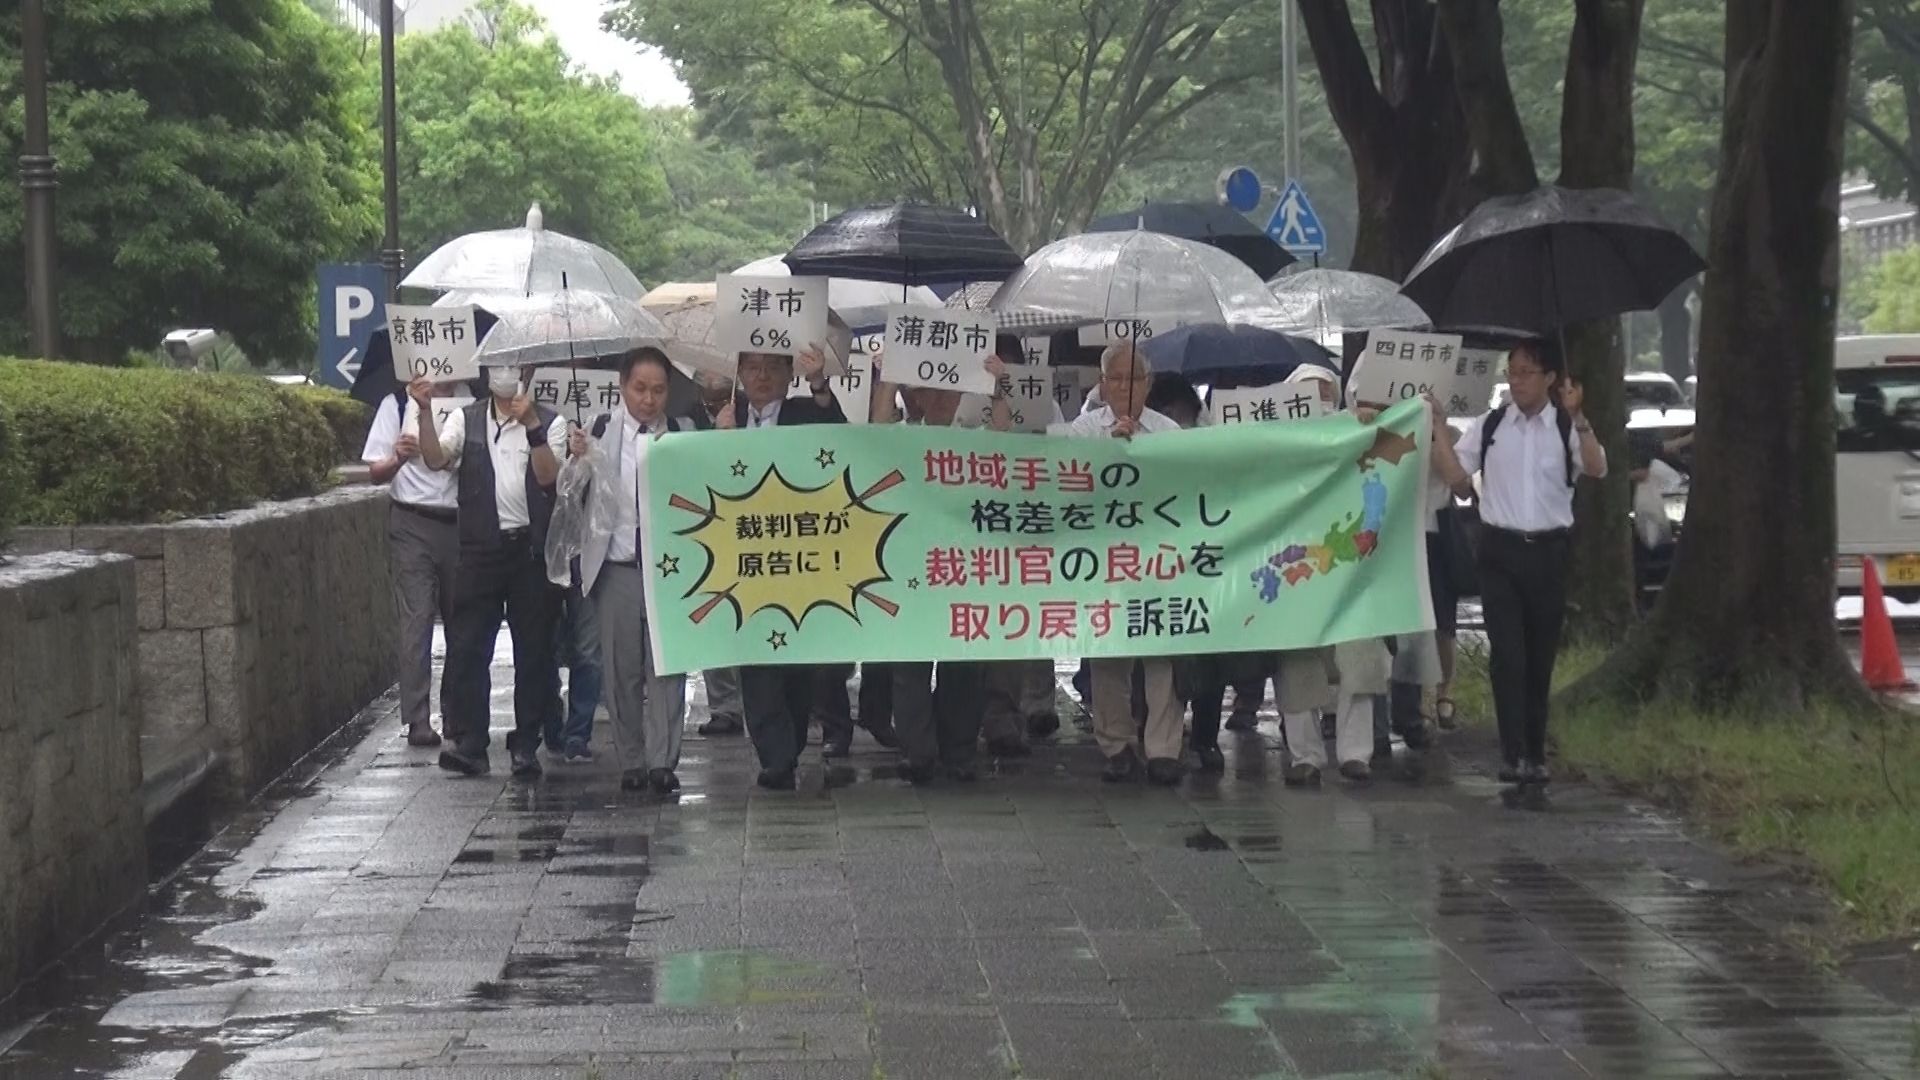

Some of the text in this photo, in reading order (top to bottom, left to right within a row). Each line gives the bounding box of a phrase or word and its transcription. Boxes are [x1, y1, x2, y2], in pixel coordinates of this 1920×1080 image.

[336, 286, 374, 337] P
[740, 287, 806, 317] 津市
[392, 316, 466, 345] 京都市
[750, 327, 792, 349] 6%
[895, 315, 991, 353] 蒲郡市
[1376, 340, 1454, 361] 四日市市
[408, 357, 453, 378] 10%
[918, 361, 959, 384] 0%
[534, 379, 620, 410] 西尾市
[924, 450, 1141, 494] 地域手当の
[736, 511, 850, 540] 裁判官が
[970, 493, 1232, 536] 格差をなくし
[737, 550, 842, 578] 原告に！
[925, 541, 1226, 587] 裁判官の良心を
[949, 596, 1211, 643] 取り戻す訴訟
